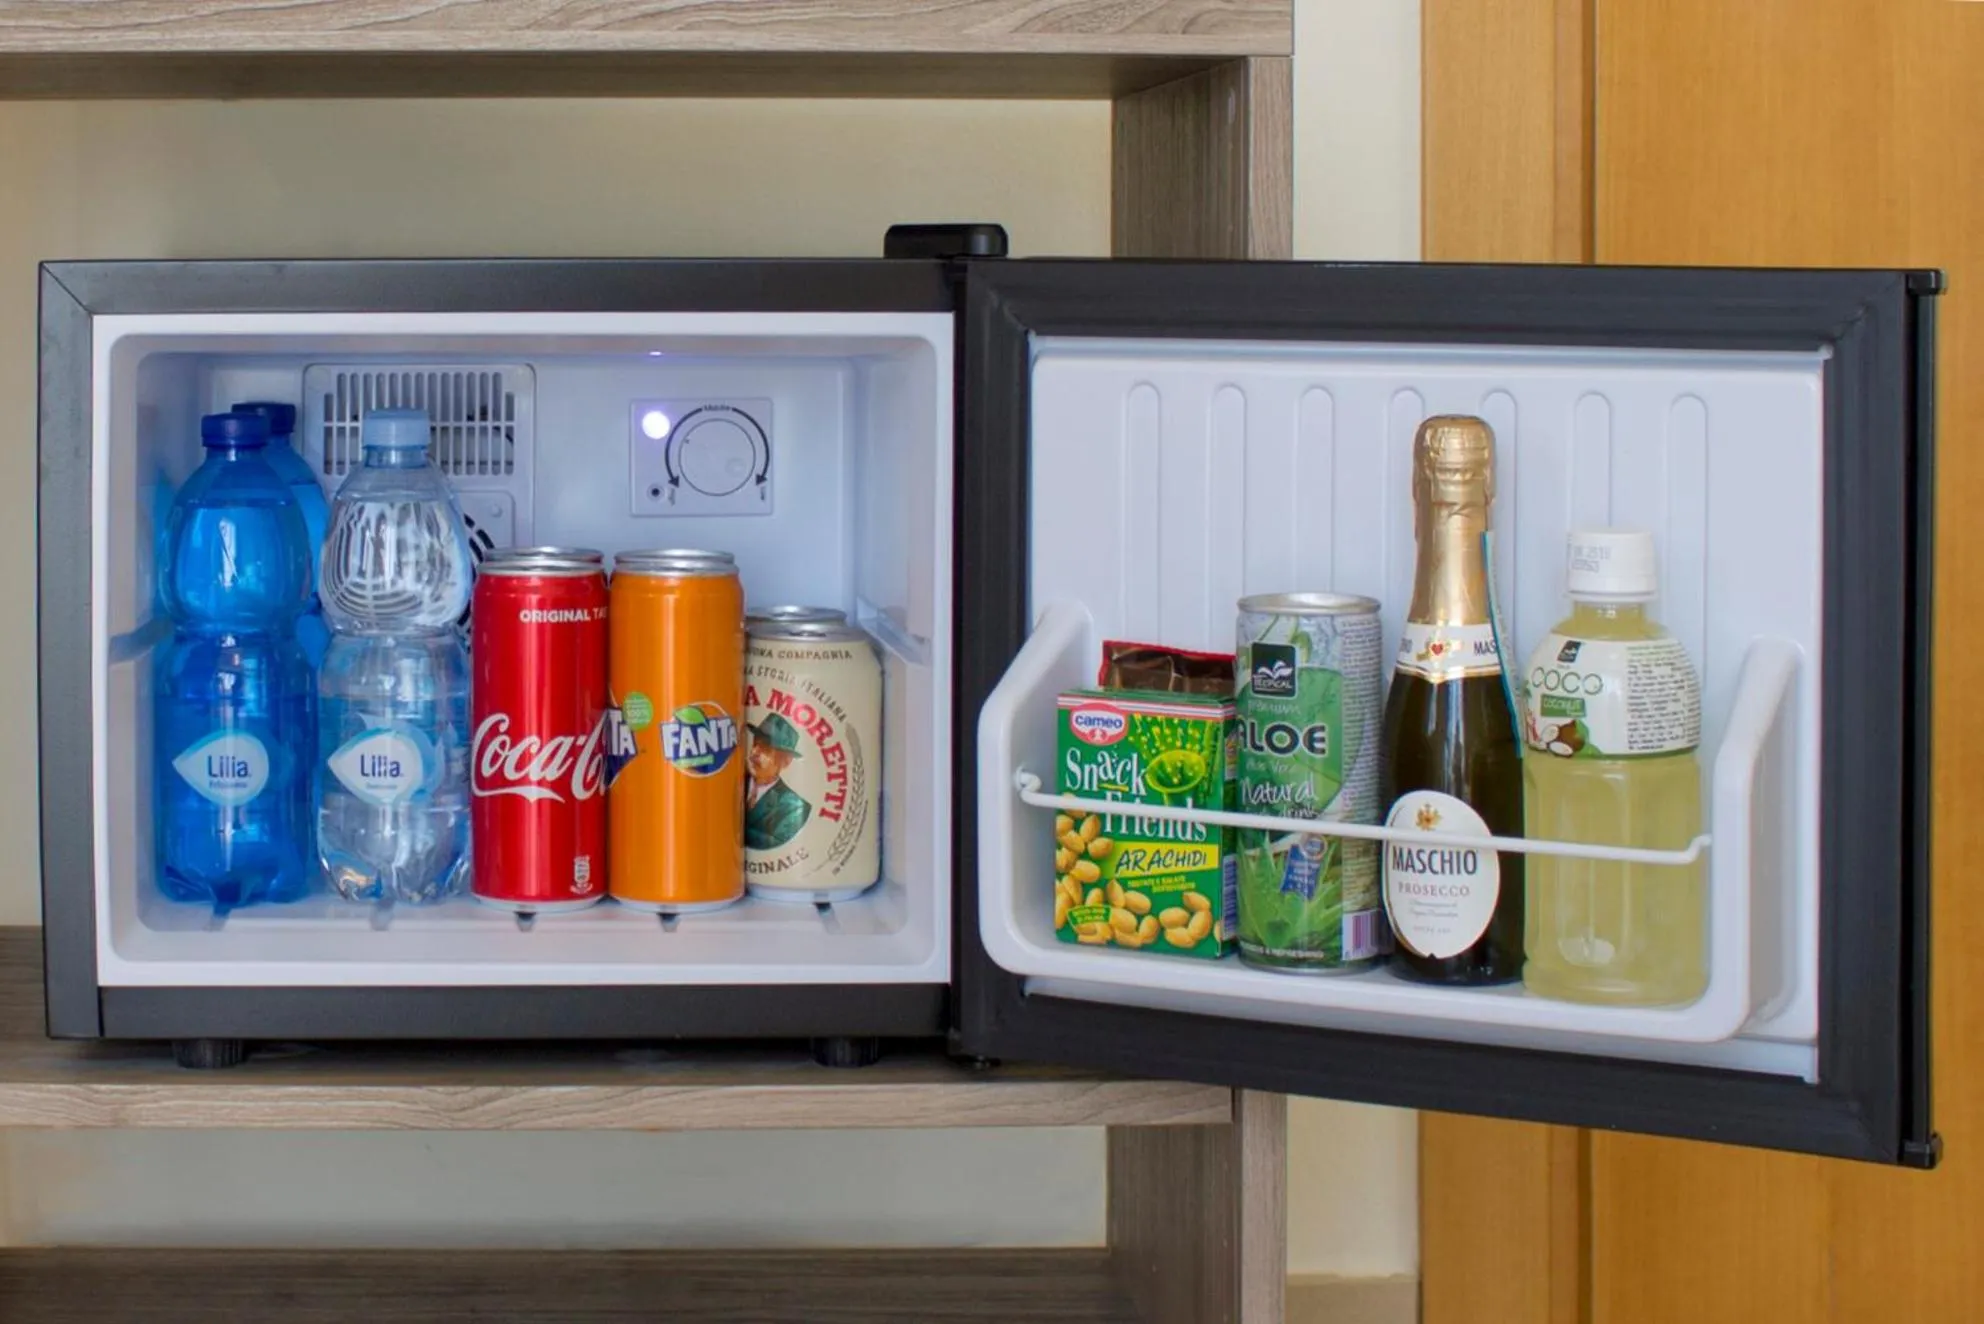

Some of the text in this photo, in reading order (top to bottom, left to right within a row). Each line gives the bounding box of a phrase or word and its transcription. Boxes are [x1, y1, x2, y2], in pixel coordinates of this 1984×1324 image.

[520, 608, 591, 623] ORIGINAL
[778, 650, 853, 661] COMPAGNIA
[1474, 640, 1498, 656] MAS
[1531, 666, 1603, 696] COCO
[606, 708, 638, 755] TA
[1075, 713, 1123, 729] cameo
[660, 717, 738, 758] FANTA
[1237, 719, 1327, 758] ALOE
[208, 755, 249, 778] Lilia
[360, 754, 401, 778] Lilia
[766, 687, 849, 823] MORETTI
[1066, 747, 1147, 797] Snack
[1241, 771, 1319, 805] Natural
[1103, 791, 1207, 841] Friends
[745, 848, 810, 875] GINALE
[1115, 848, 1207, 873] ARACHIDI
[1392, 846, 1478, 876] MASCHIO
[1399, 881, 1471, 897] PROSECCO
